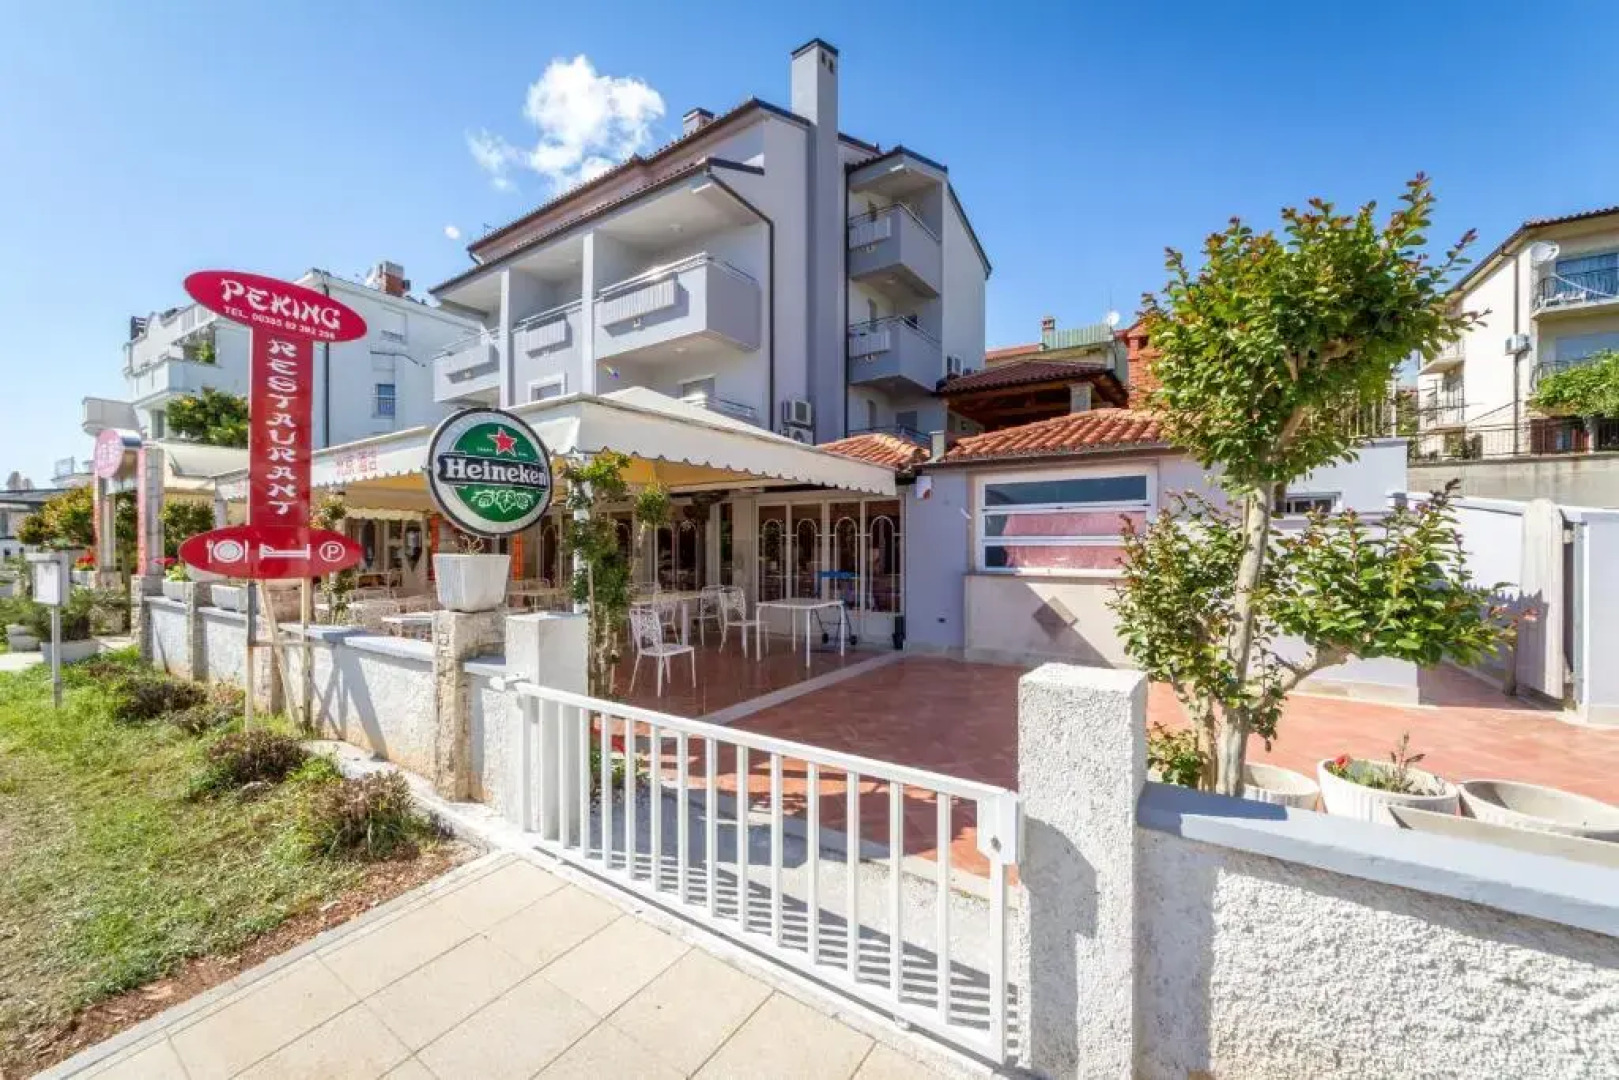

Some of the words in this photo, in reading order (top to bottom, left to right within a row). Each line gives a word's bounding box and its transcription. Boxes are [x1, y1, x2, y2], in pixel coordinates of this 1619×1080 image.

[220, 278, 341, 330] PEKING
[266, 338, 298, 515] RESTAURANT
[445, 458, 547, 486] Heineken
